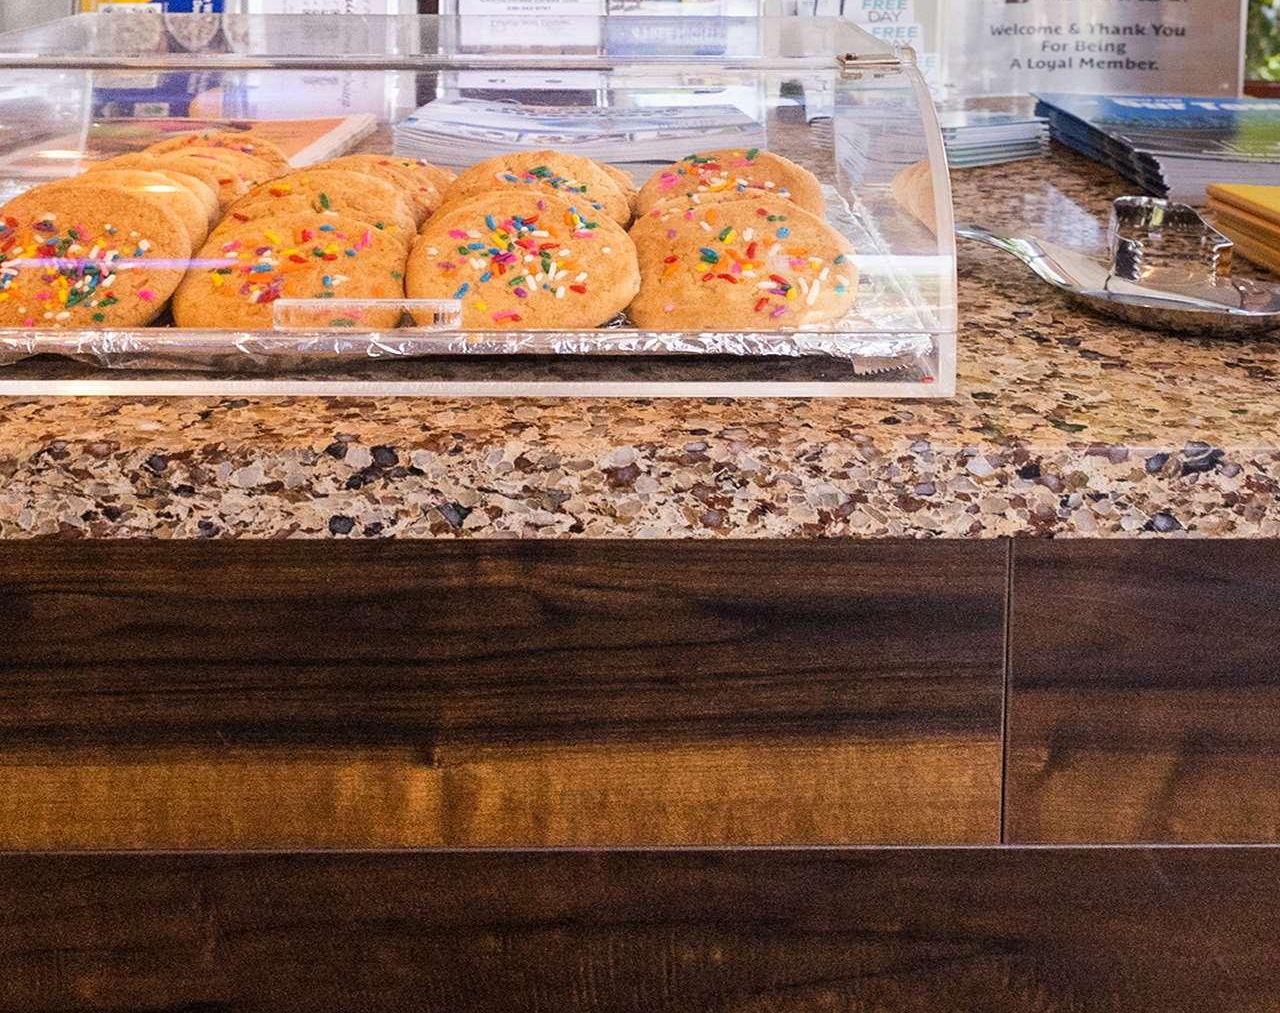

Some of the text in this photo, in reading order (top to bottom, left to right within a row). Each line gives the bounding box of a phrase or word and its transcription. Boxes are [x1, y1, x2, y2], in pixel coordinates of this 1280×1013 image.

[868, 10, 903, 23] DAY
[872, 26, 918, 38] FREE
[990, 23, 1187, 37] Welcome & Thank You
[1041, 40, 1127, 55] For Being
[1009, 58, 1021, 70] A
[1026, 57, 1073, 72] Loyal
